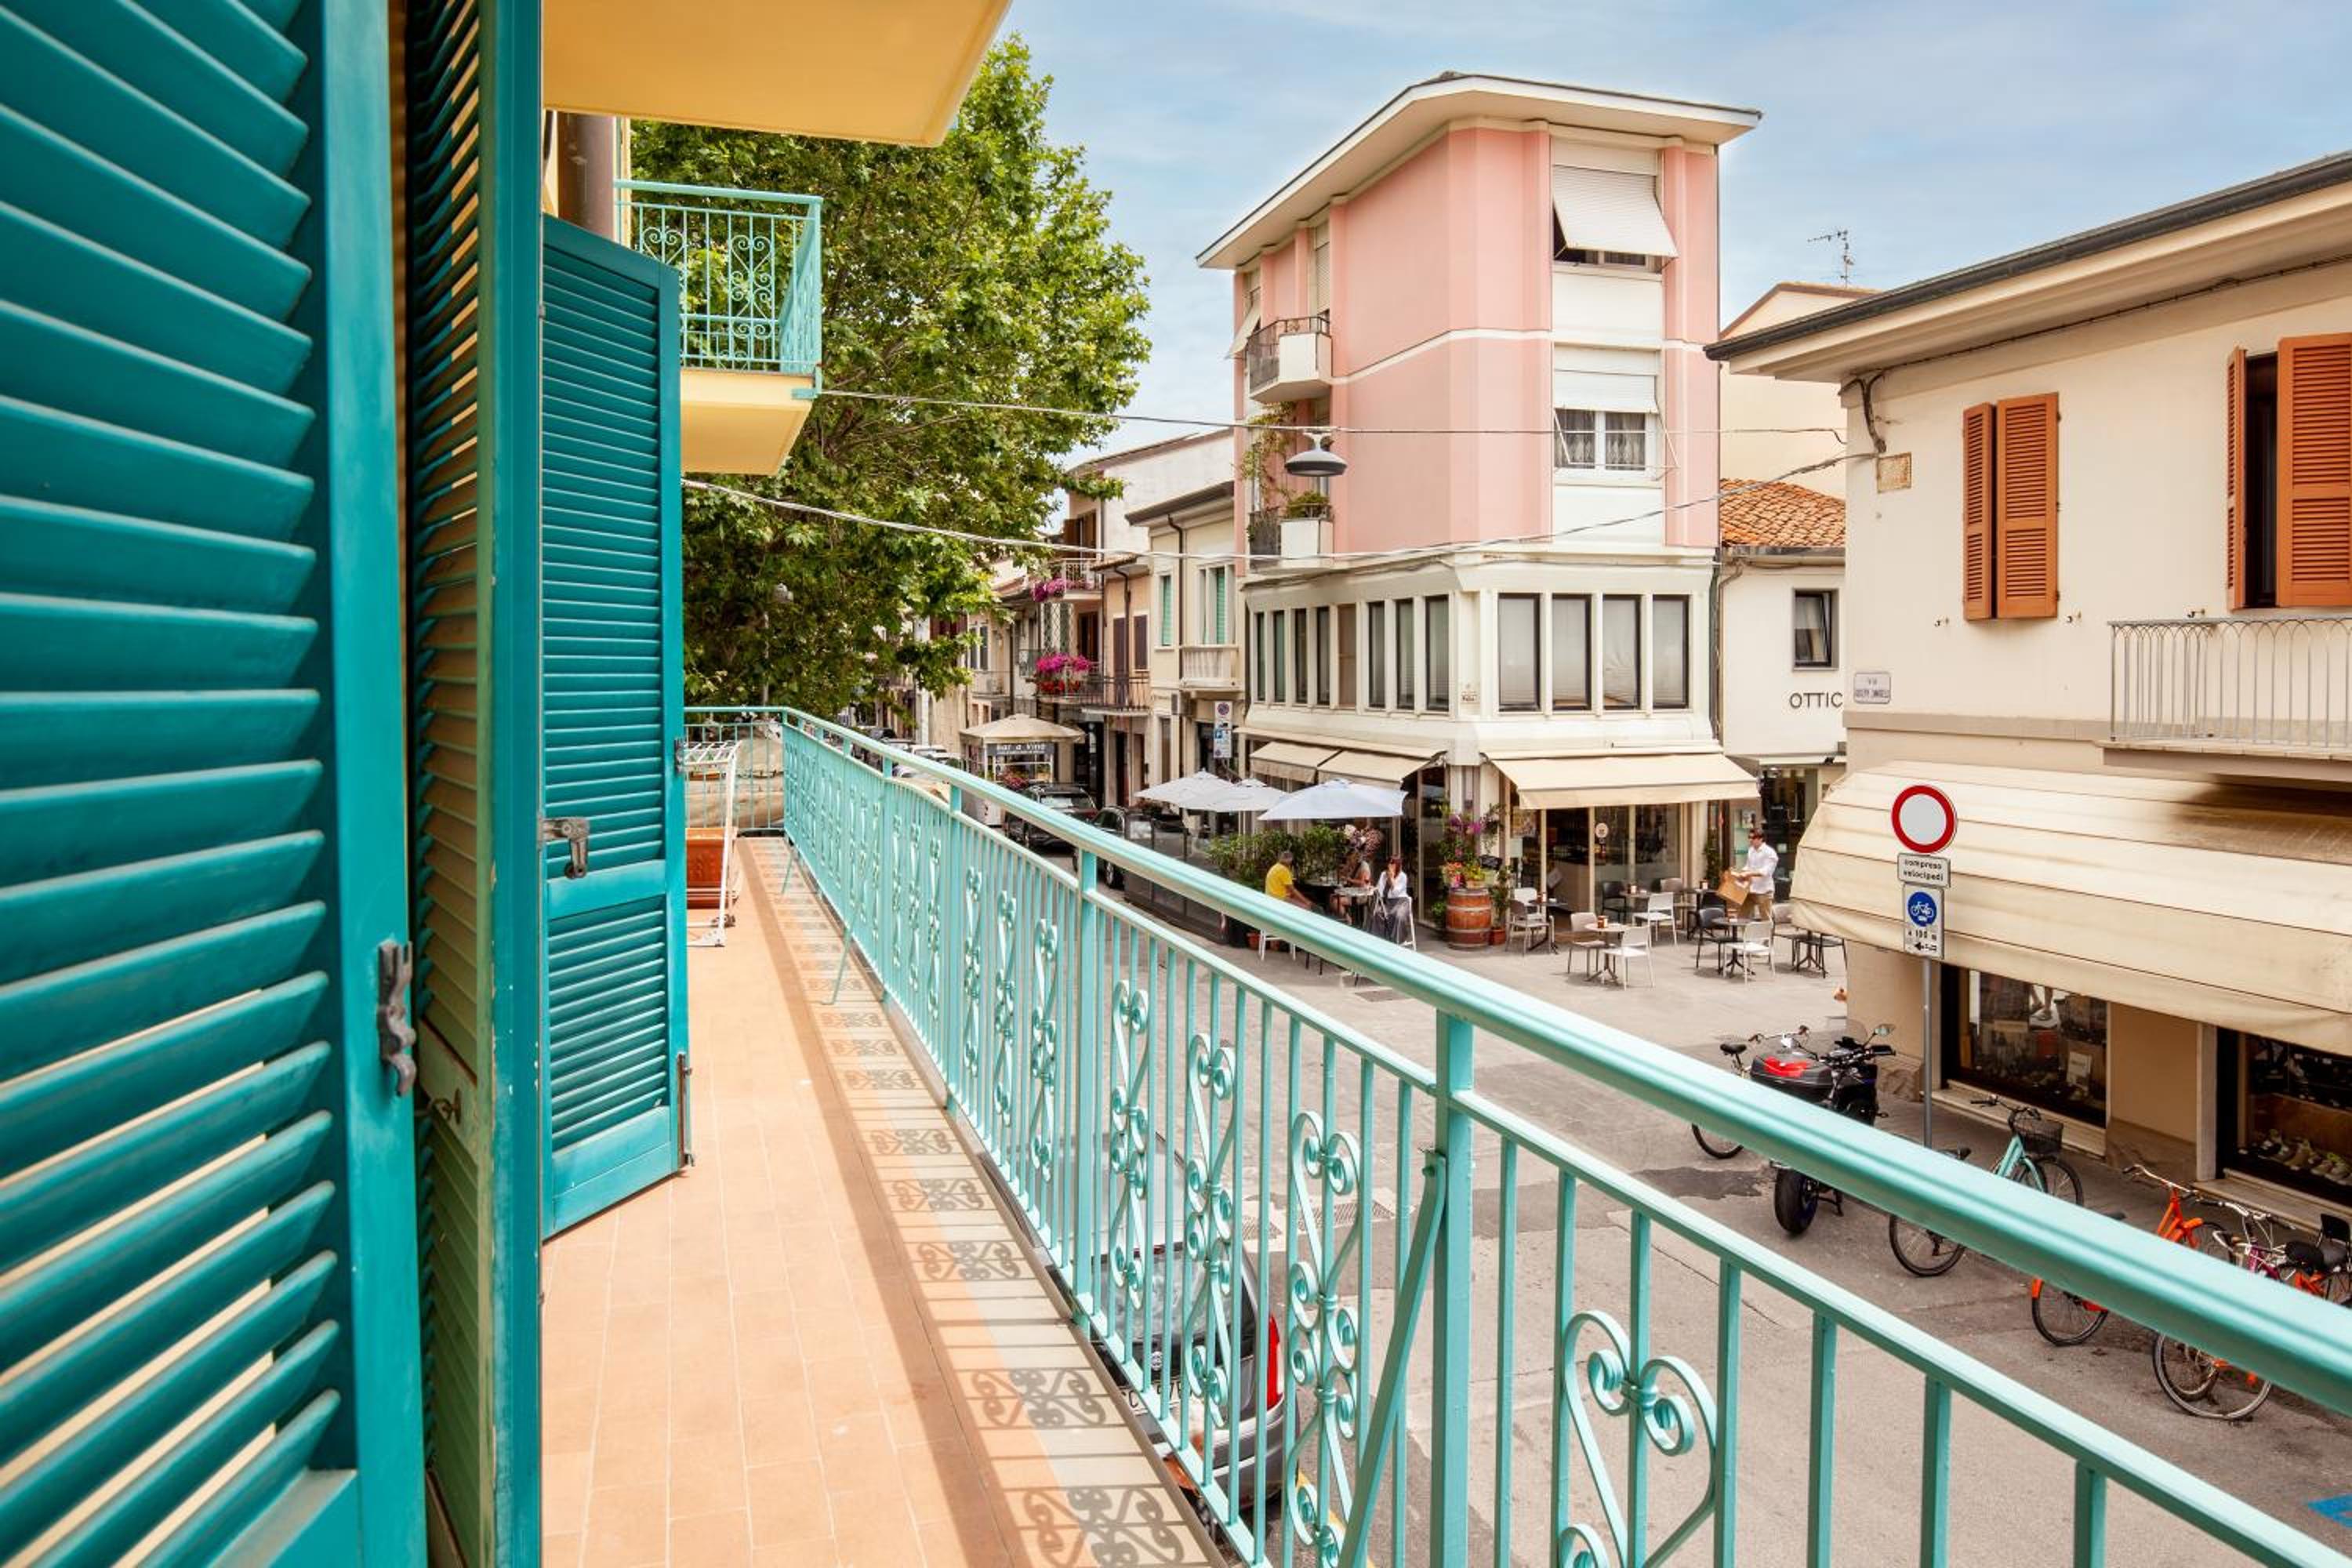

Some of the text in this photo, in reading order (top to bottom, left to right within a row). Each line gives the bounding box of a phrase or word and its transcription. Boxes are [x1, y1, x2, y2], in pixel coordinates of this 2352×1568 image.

[1790, 692, 1843, 709] OTTIC
[1904, 859, 1942, 869] compreso
[1904, 870, 1944, 881] velocipedi
